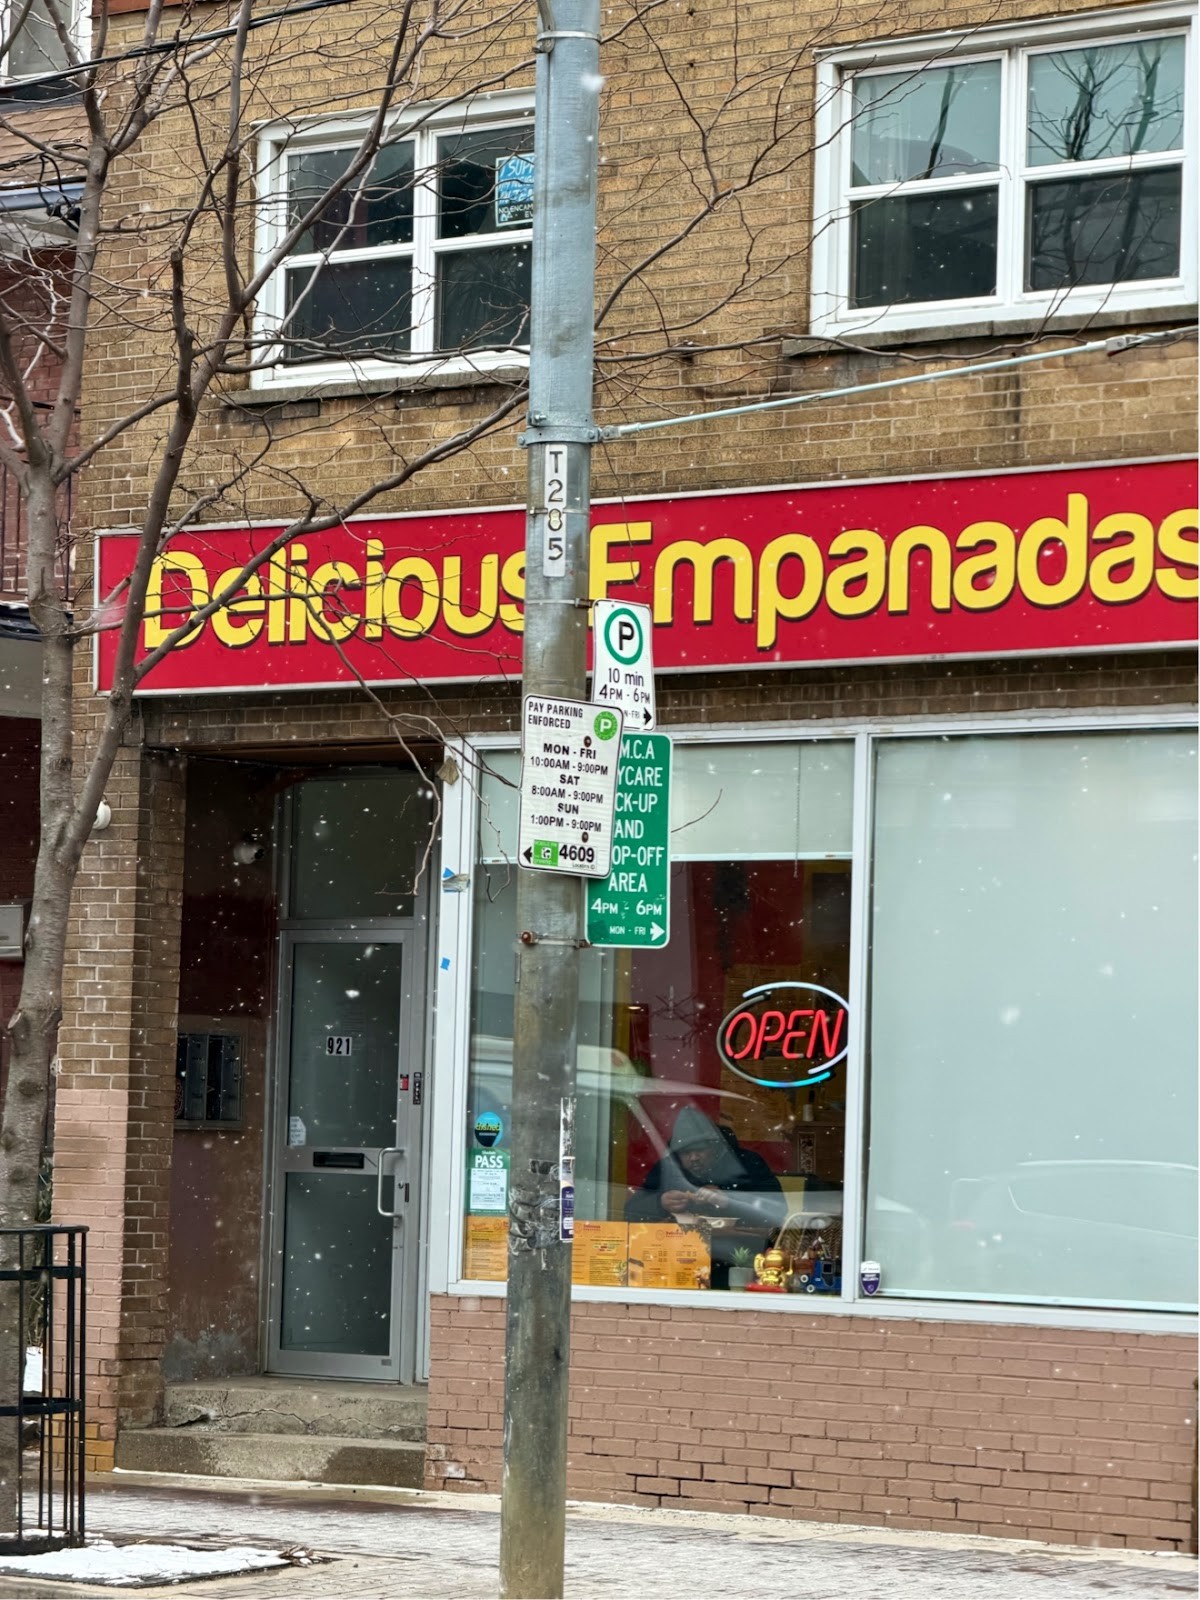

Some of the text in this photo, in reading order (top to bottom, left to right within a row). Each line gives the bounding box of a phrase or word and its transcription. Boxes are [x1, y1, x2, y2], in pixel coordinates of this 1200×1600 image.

[588, 491, 1199, 652] Empanadas
[618, 621, 635, 651] P
[608, 667, 644, 687] 10 min
[599, 684, 623, 700] 4PM
[633, 688, 651, 704] 6PM
[528, 701, 583, 718] PAY PARKING
[528, 715, 571, 729] ENFORCED
[543, 743, 570, 755] MON
[580, 748, 596, 759] FRI
[530, 756, 570, 770] 10:00AM
[577, 762, 608, 775] 9:00PM
[560, 774, 580, 786] SAT
[531, 785, 566, 798] 8:00AM
[573, 790, 604, 804] 9:00PM
[615, 792, 658, 813] CK-UP
[557, 803, 579, 815] SUN
[531, 814, 564, 827] 1:00PM
[571, 819, 602, 832] 9:00PM
[614, 818, 644, 839] AND
[559, 844, 595, 863] 4609
[612, 845, 665, 867] OP-OFF
[608, 872, 648, 893] AREA
[591, 897, 619, 914] 4PM
[636, 900, 662, 916] 6PM
[609, 925, 625, 935] MON
[634, 926, 646, 935] FRI
[725, 1008, 845, 1060] OPEN
[327, 1037, 350, 1055] 921
[475, 1154, 504, 1169] PASS
